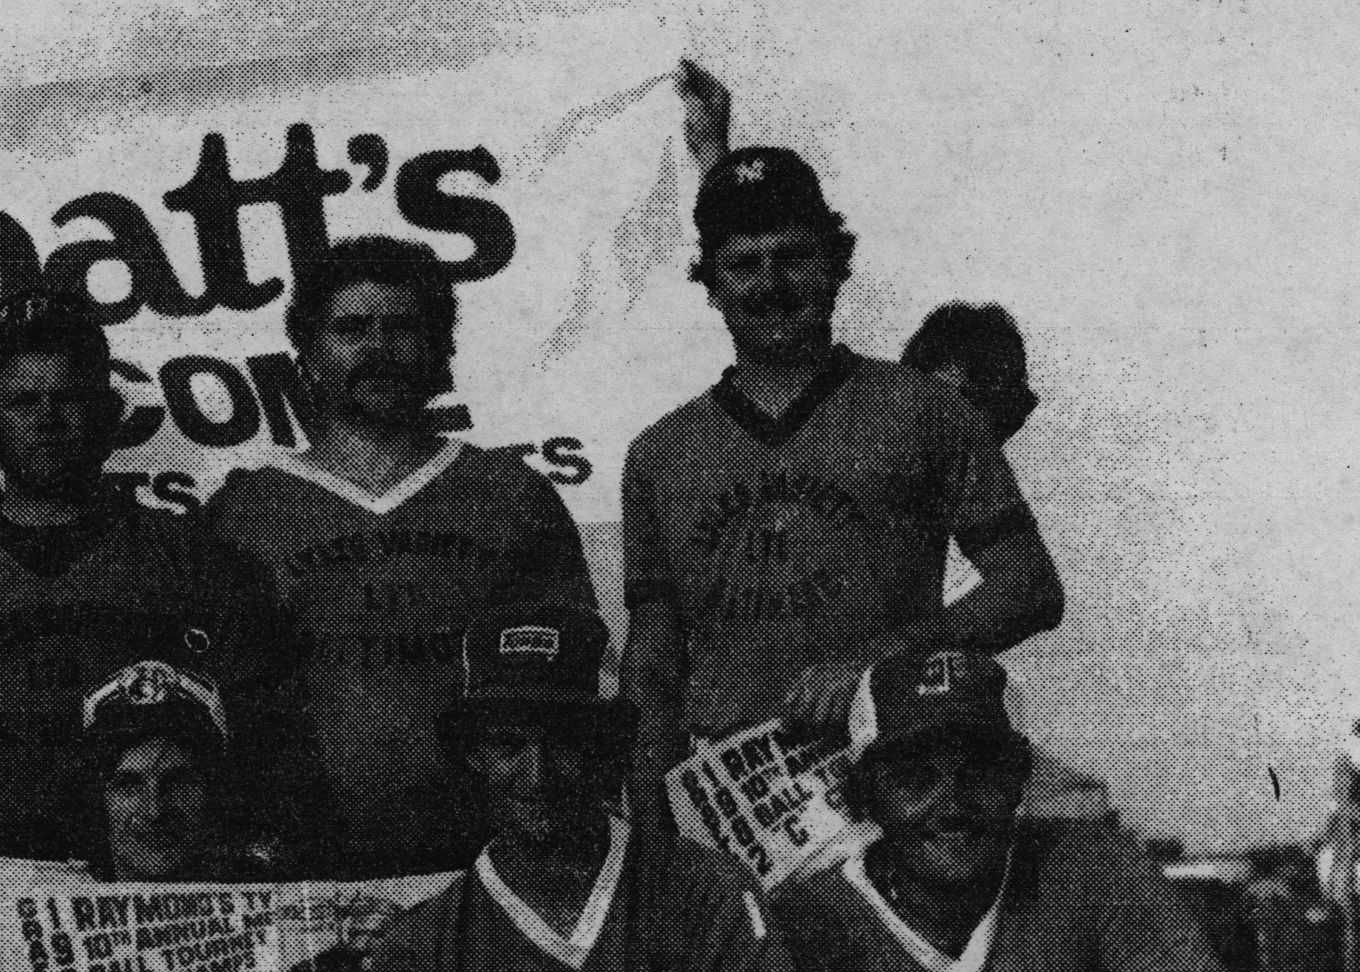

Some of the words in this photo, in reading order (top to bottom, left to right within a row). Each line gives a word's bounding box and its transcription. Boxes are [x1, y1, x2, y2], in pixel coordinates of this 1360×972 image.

[72, 891, 235, 931] RAYMOND'S
[136, 917, 234, 949] ANNUAL
[160, 930, 268, 971] TOURNEY
